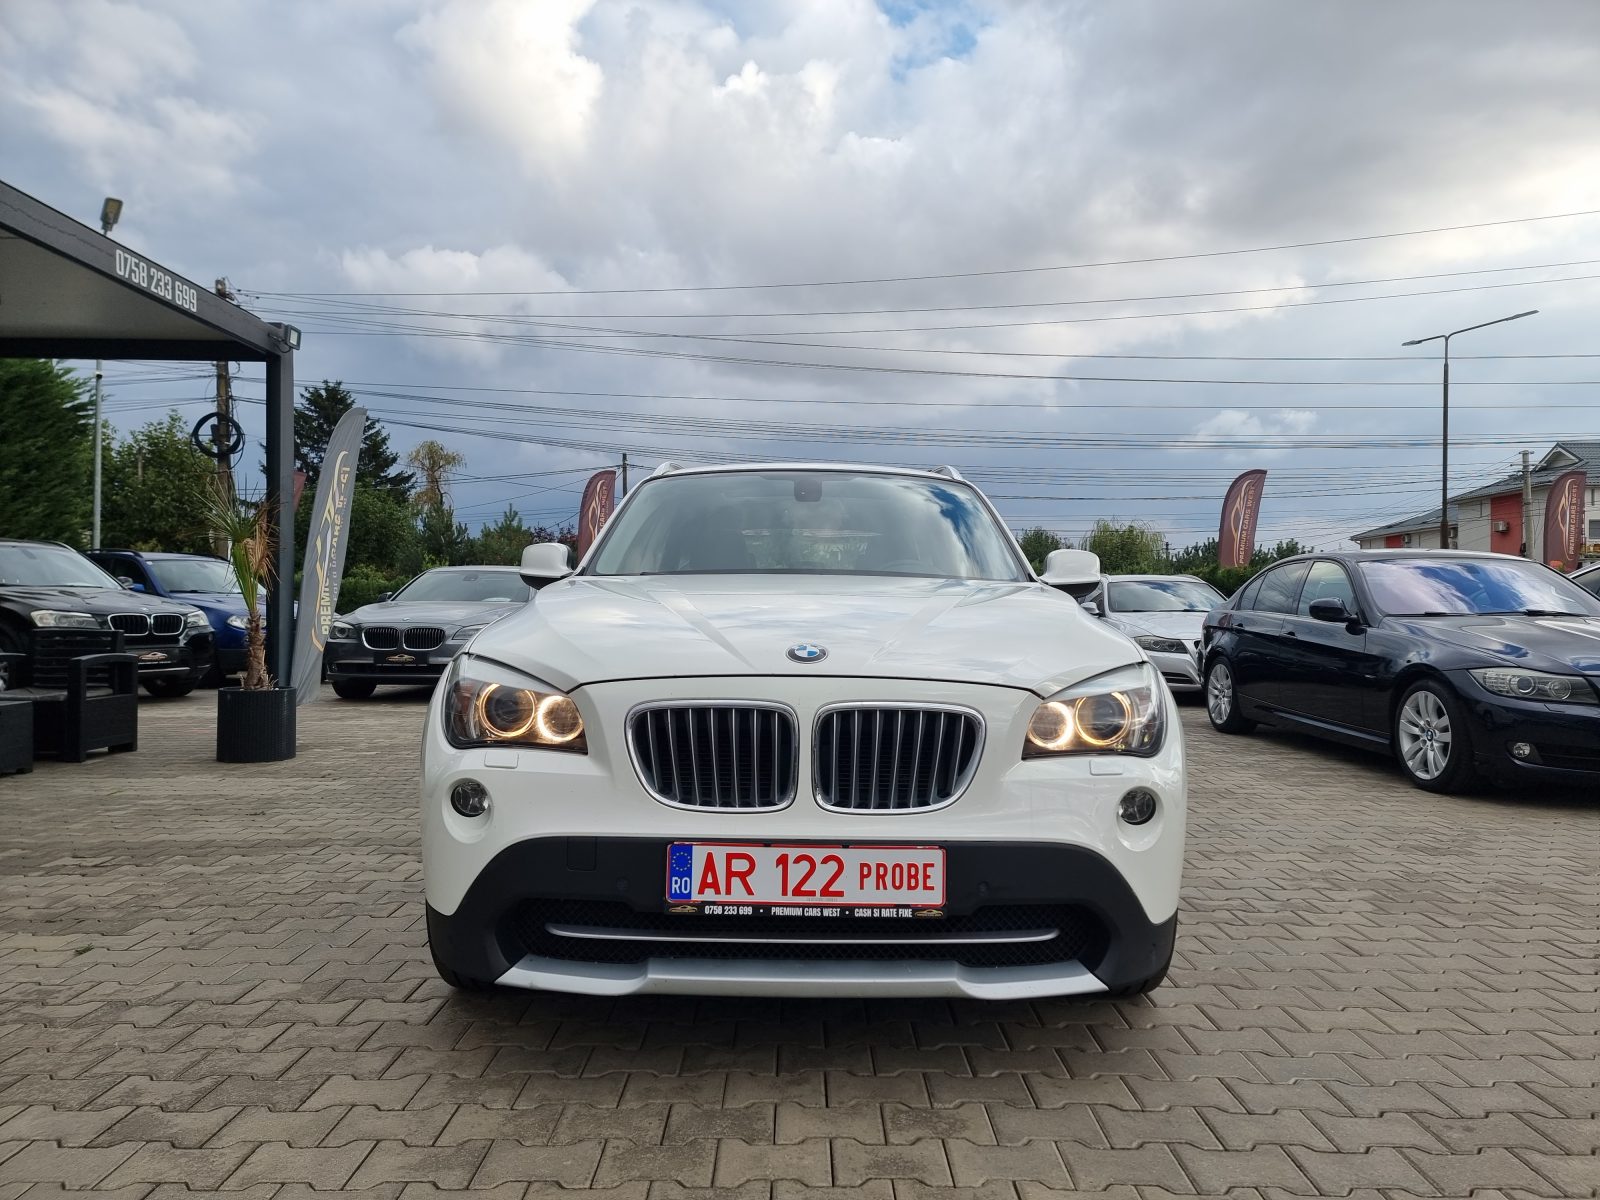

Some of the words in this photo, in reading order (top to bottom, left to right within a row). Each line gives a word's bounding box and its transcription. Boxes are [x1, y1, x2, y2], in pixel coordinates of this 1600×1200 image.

[116, 249, 148, 288] 0758
[150, 267, 172, 300] 233
[175, 281, 197, 312] 699
[1243, 510, 1251, 528] CARS
[1240, 531, 1248, 564] PREMIUM
[697, 851, 755, 895] AR
[775, 853, 844, 898] 122
[859, 862, 935, 891] PROBE
[671, 876, 691, 894] RO
[704, 905, 723, 915] 0758
[724, 905, 737, 915] 233
[738, 906, 753, 915] 699
[771, 906, 803, 917] PREMIUM
[804, 907, 821, 917] CARS
[822, 908, 841, 918] WEST
[854, 908, 872, 918] CASH
[873, 908, 880, 918] SI
[881, 908, 897, 918] RATE
[898, 908, 913, 918] FIXE
